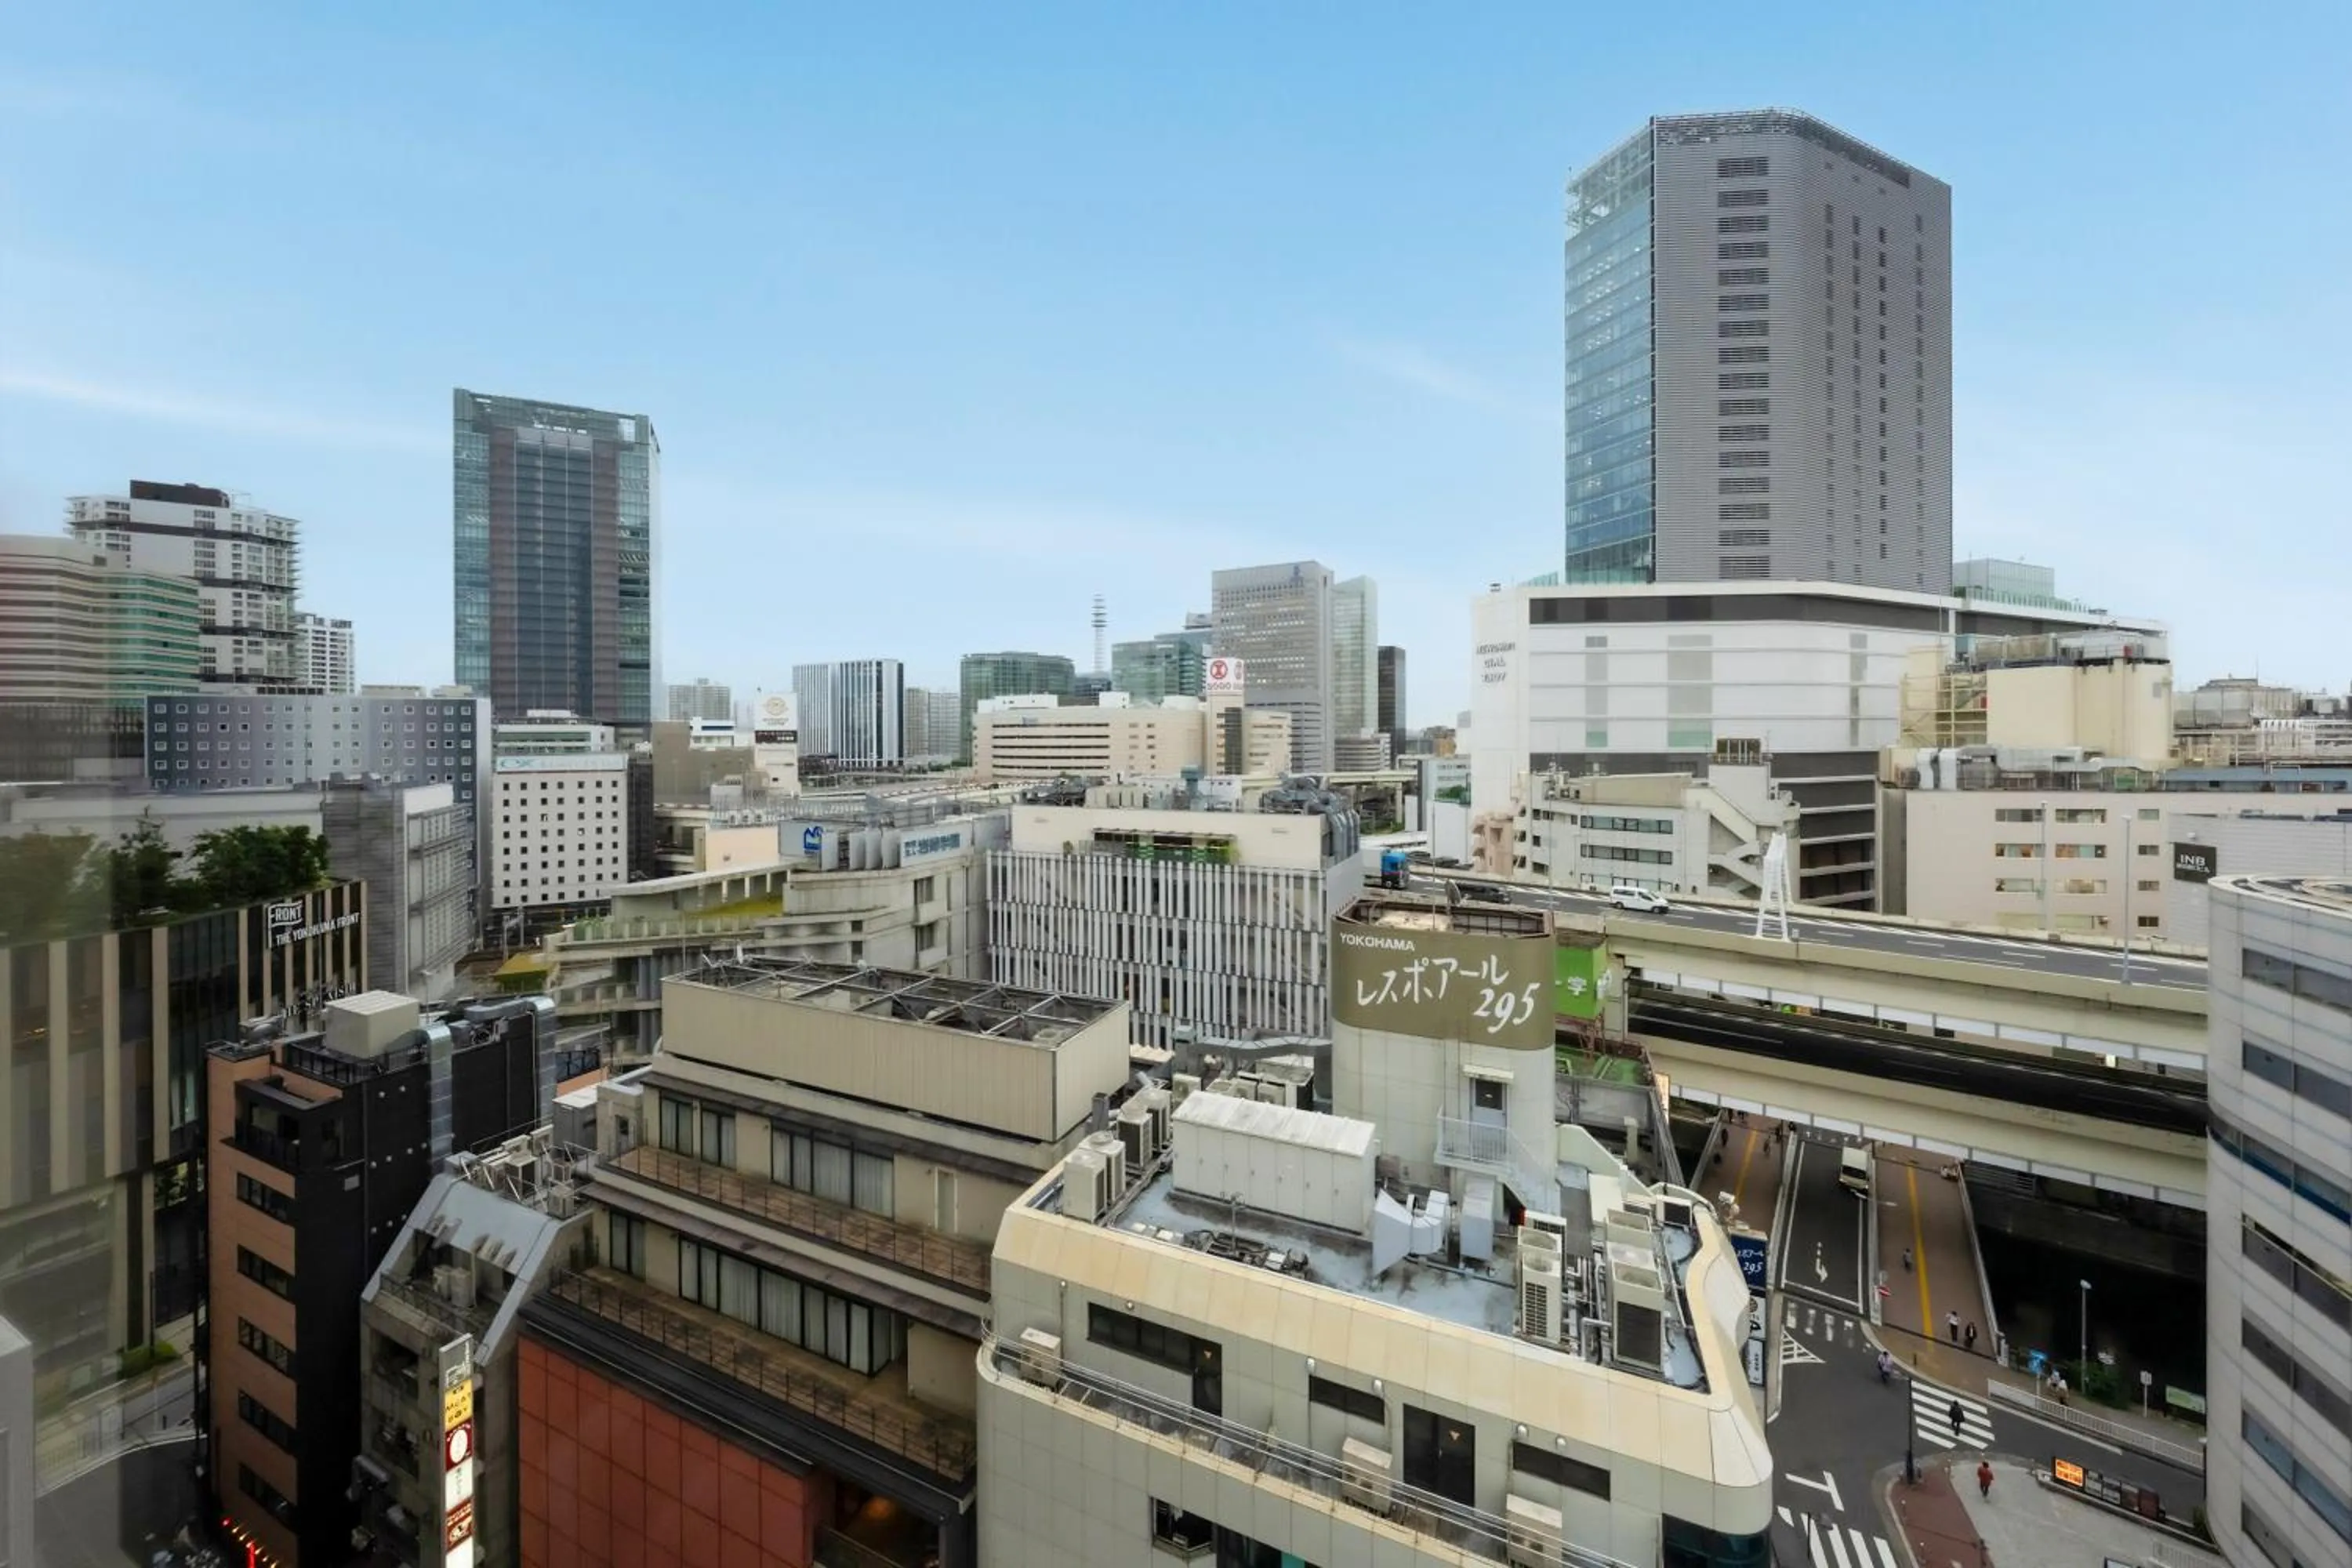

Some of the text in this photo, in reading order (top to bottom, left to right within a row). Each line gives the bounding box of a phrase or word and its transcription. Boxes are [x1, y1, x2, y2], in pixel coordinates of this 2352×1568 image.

[268, 902, 303, 928] FRONT
[276, 931, 292, 946] THE
[337, 912, 361, 929] FRONT
[1339, 932, 1416, 951] YOKOHAMA
[1357, 953, 1509, 1007] レスポアール
[1473, 982, 1541, 1034] 295
[1744, 1261, 1763, 1276] 295
